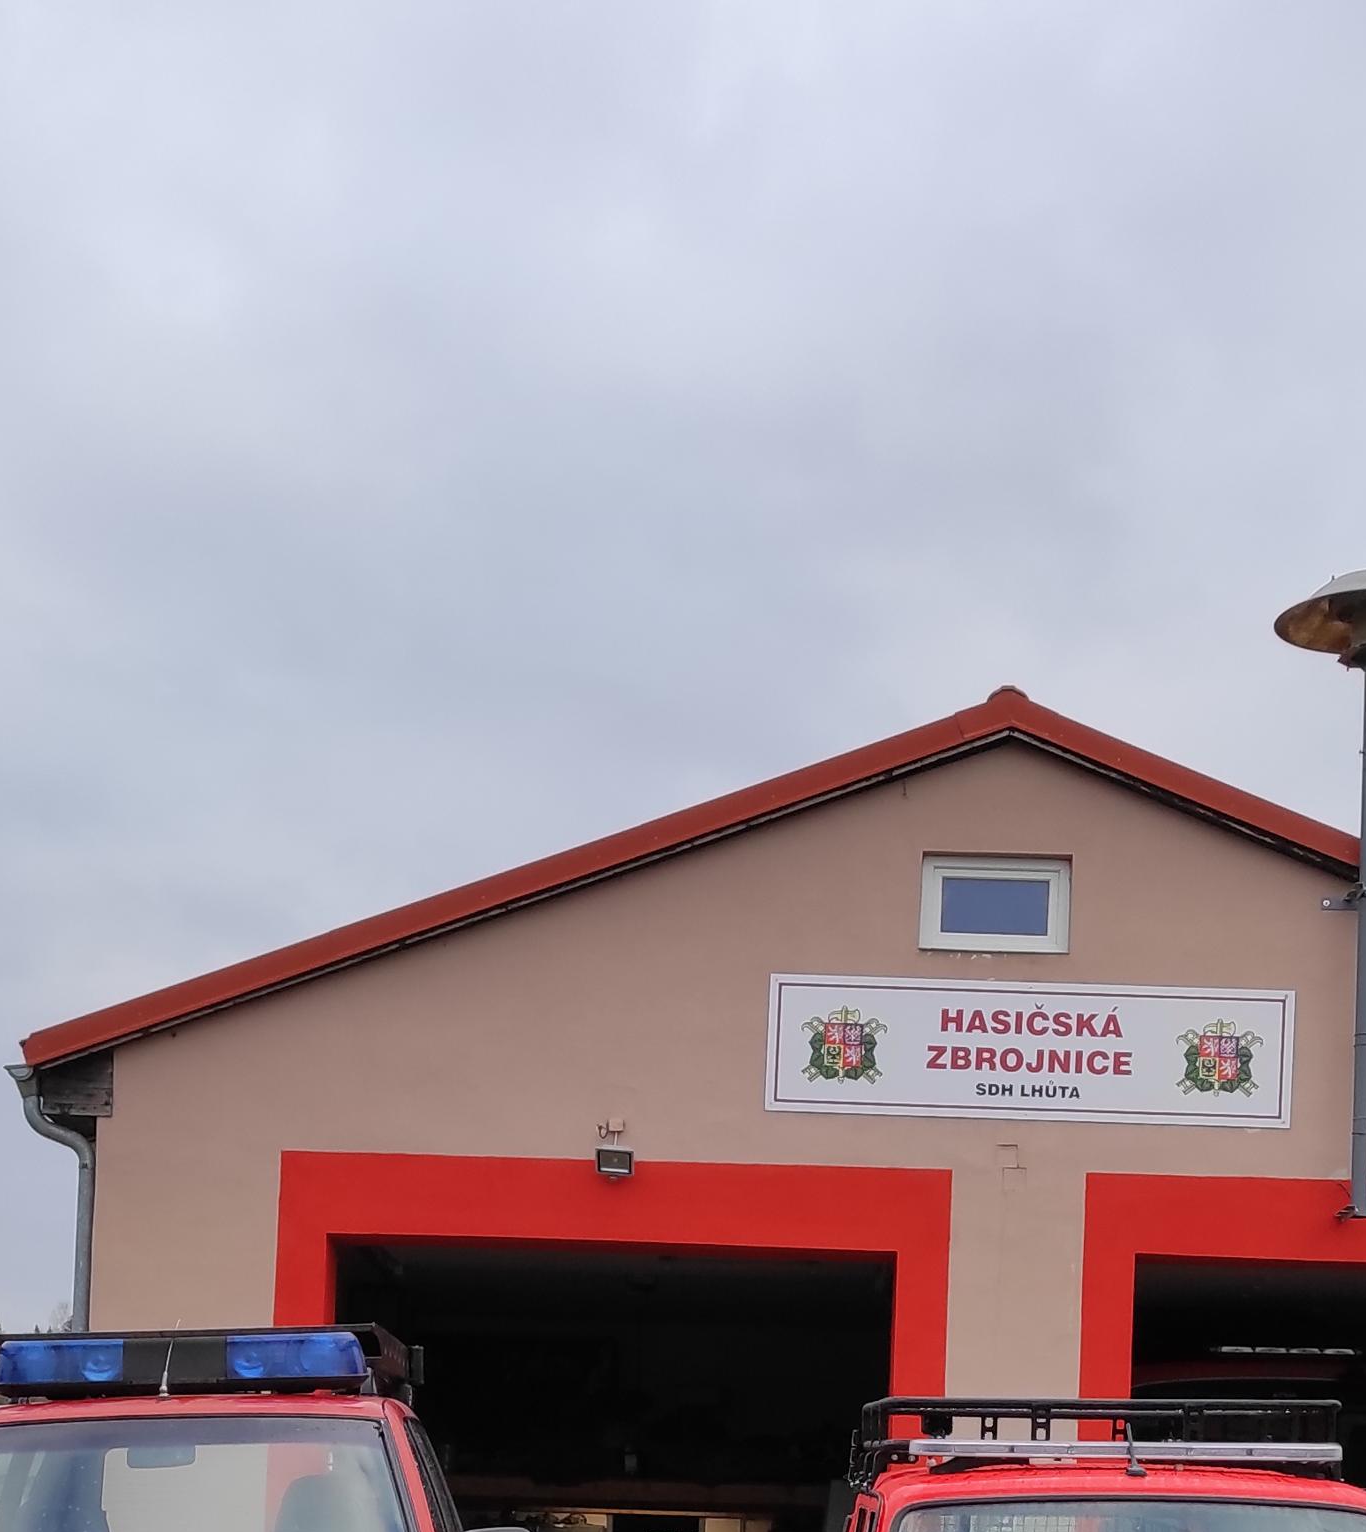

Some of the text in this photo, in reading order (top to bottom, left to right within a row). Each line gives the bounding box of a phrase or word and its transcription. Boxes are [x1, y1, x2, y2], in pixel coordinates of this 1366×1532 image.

[940, 1003, 1123, 1038] HASIČSKÁ
[926, 1045, 1133, 1076] ZBROJNICE
[975, 1080, 1080, 1099] SDH LHŮTA
